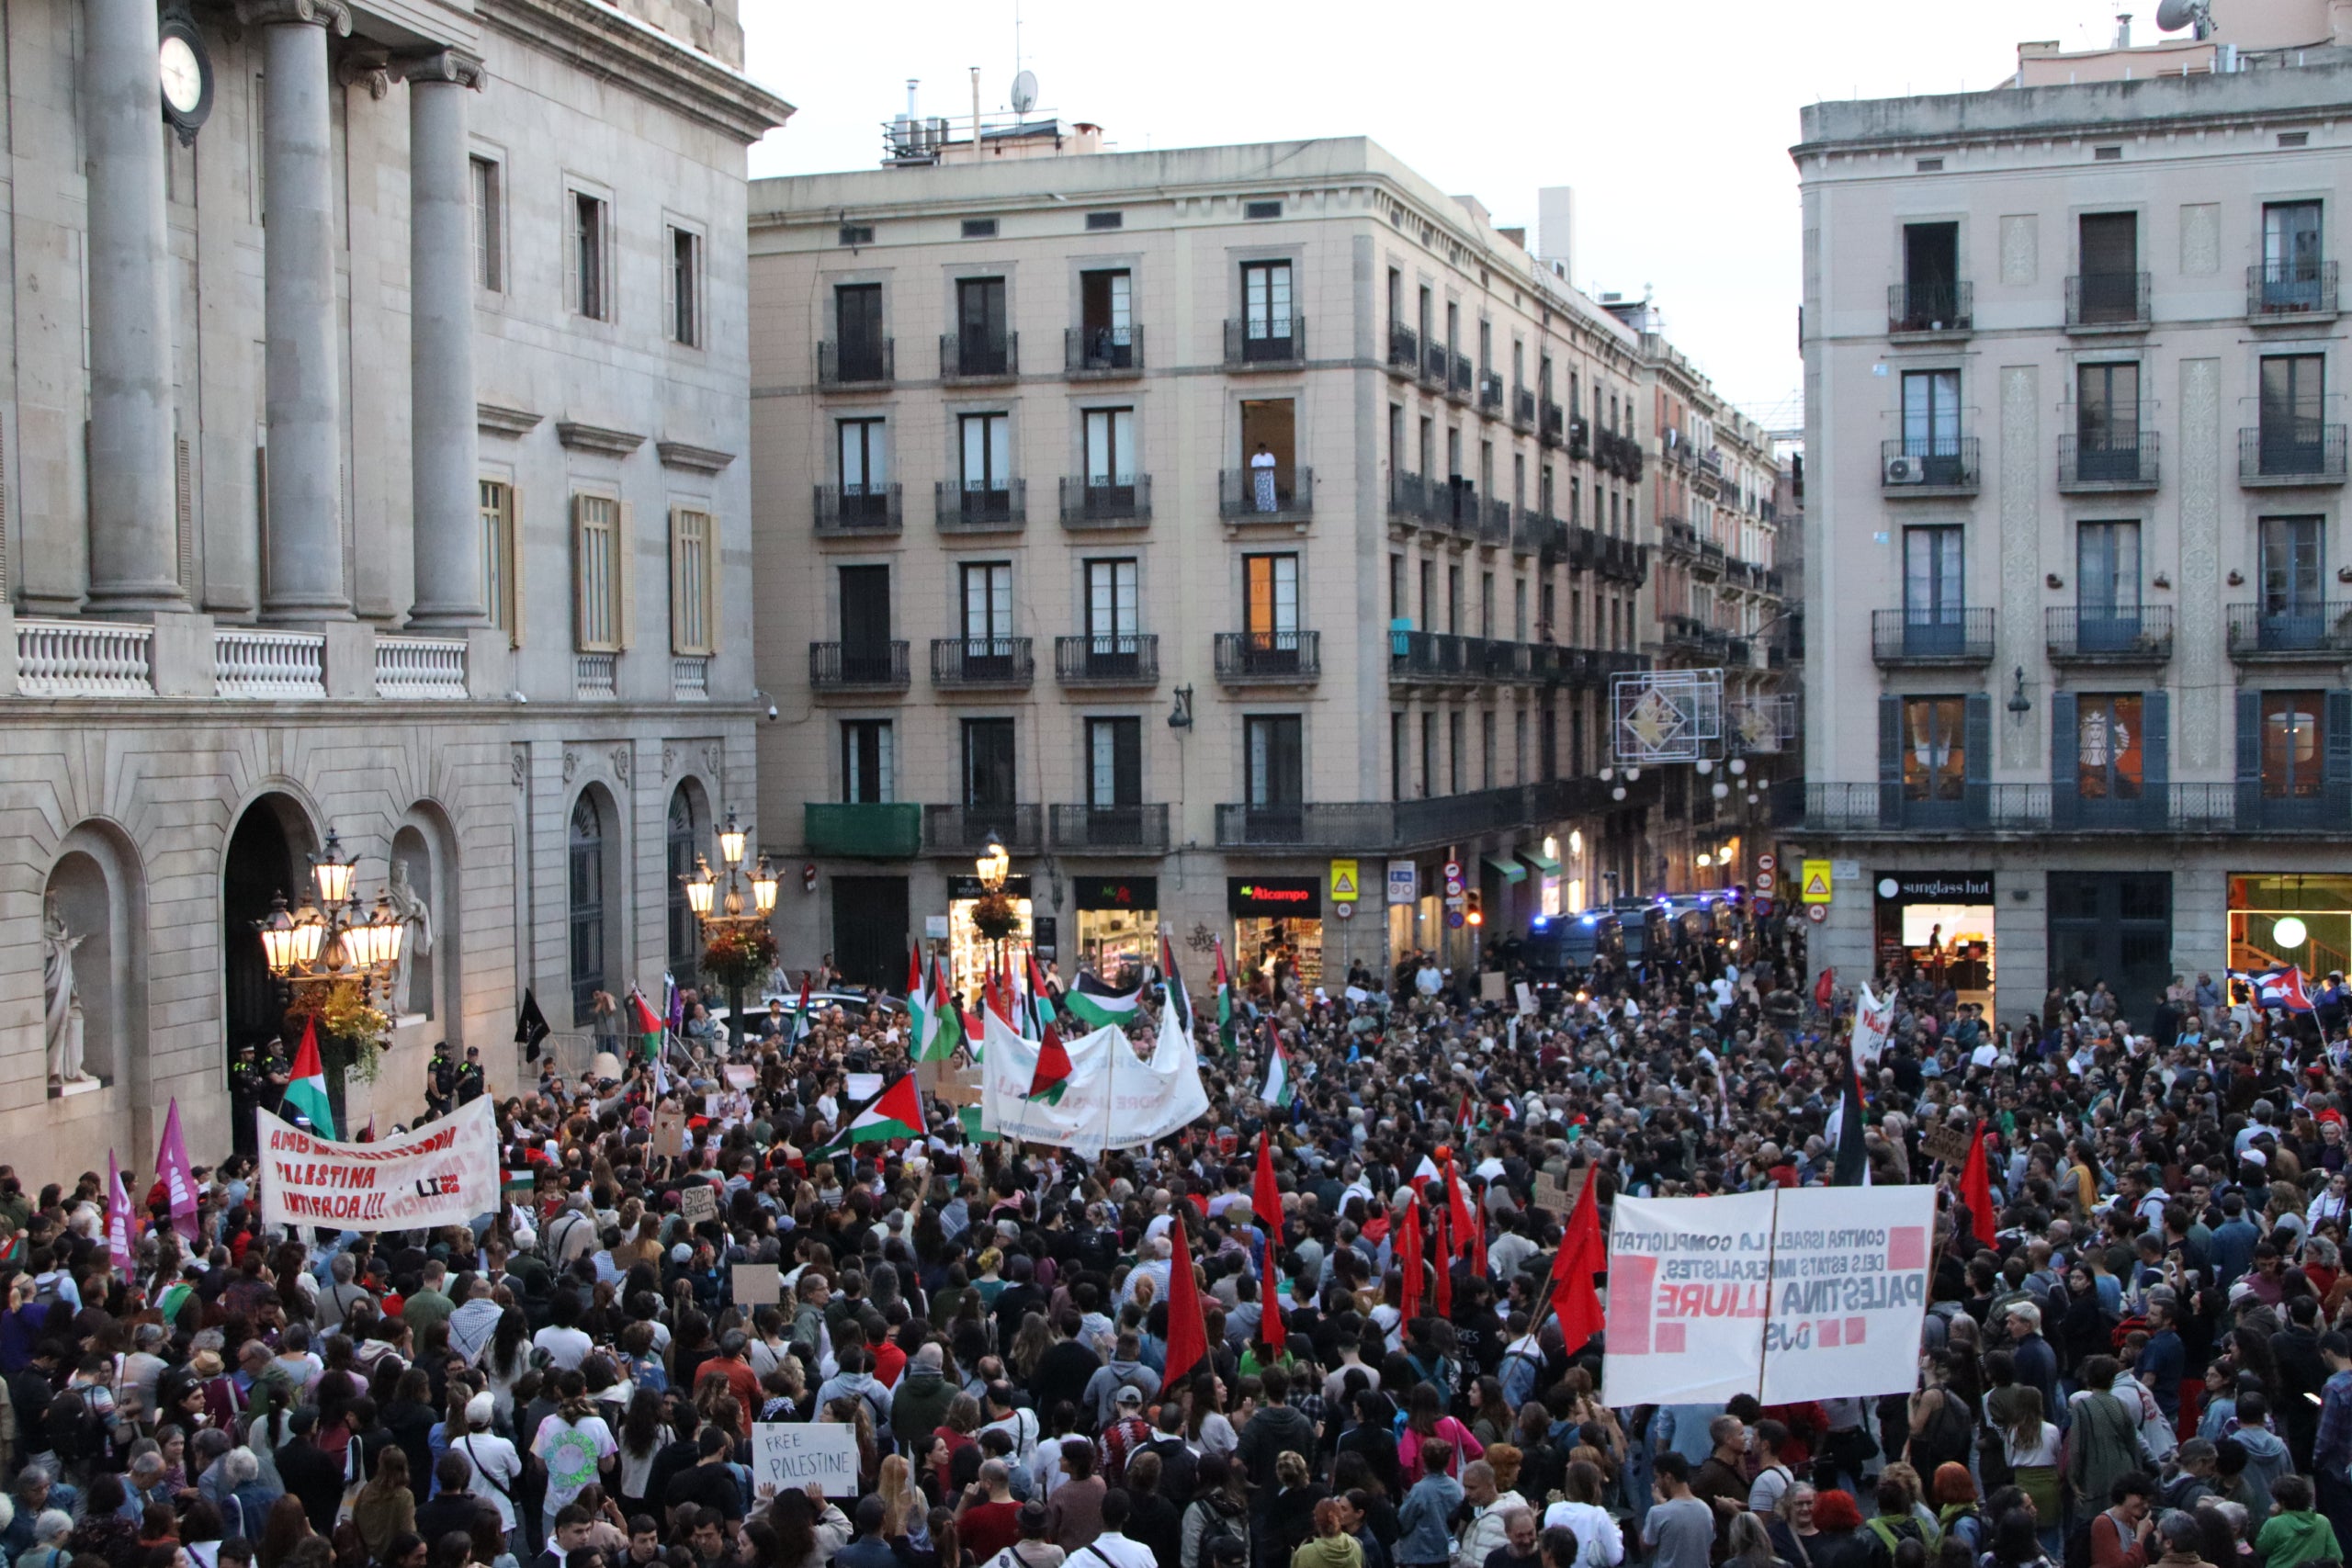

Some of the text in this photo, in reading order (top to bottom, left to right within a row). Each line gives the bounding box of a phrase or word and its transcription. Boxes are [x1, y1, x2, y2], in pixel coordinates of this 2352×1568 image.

[1251, 886, 1309, 902] Alcampo
[1903, 879, 1990, 897] sunglass hut
[271, 1130, 310, 1154] AMB
[276, 1162, 377, 1190] PALESTINA
[685, 1188, 708, 1205] STOP
[765, 1433, 802, 1452] FREE
[770, 1451, 851, 1481] PALESTINE
